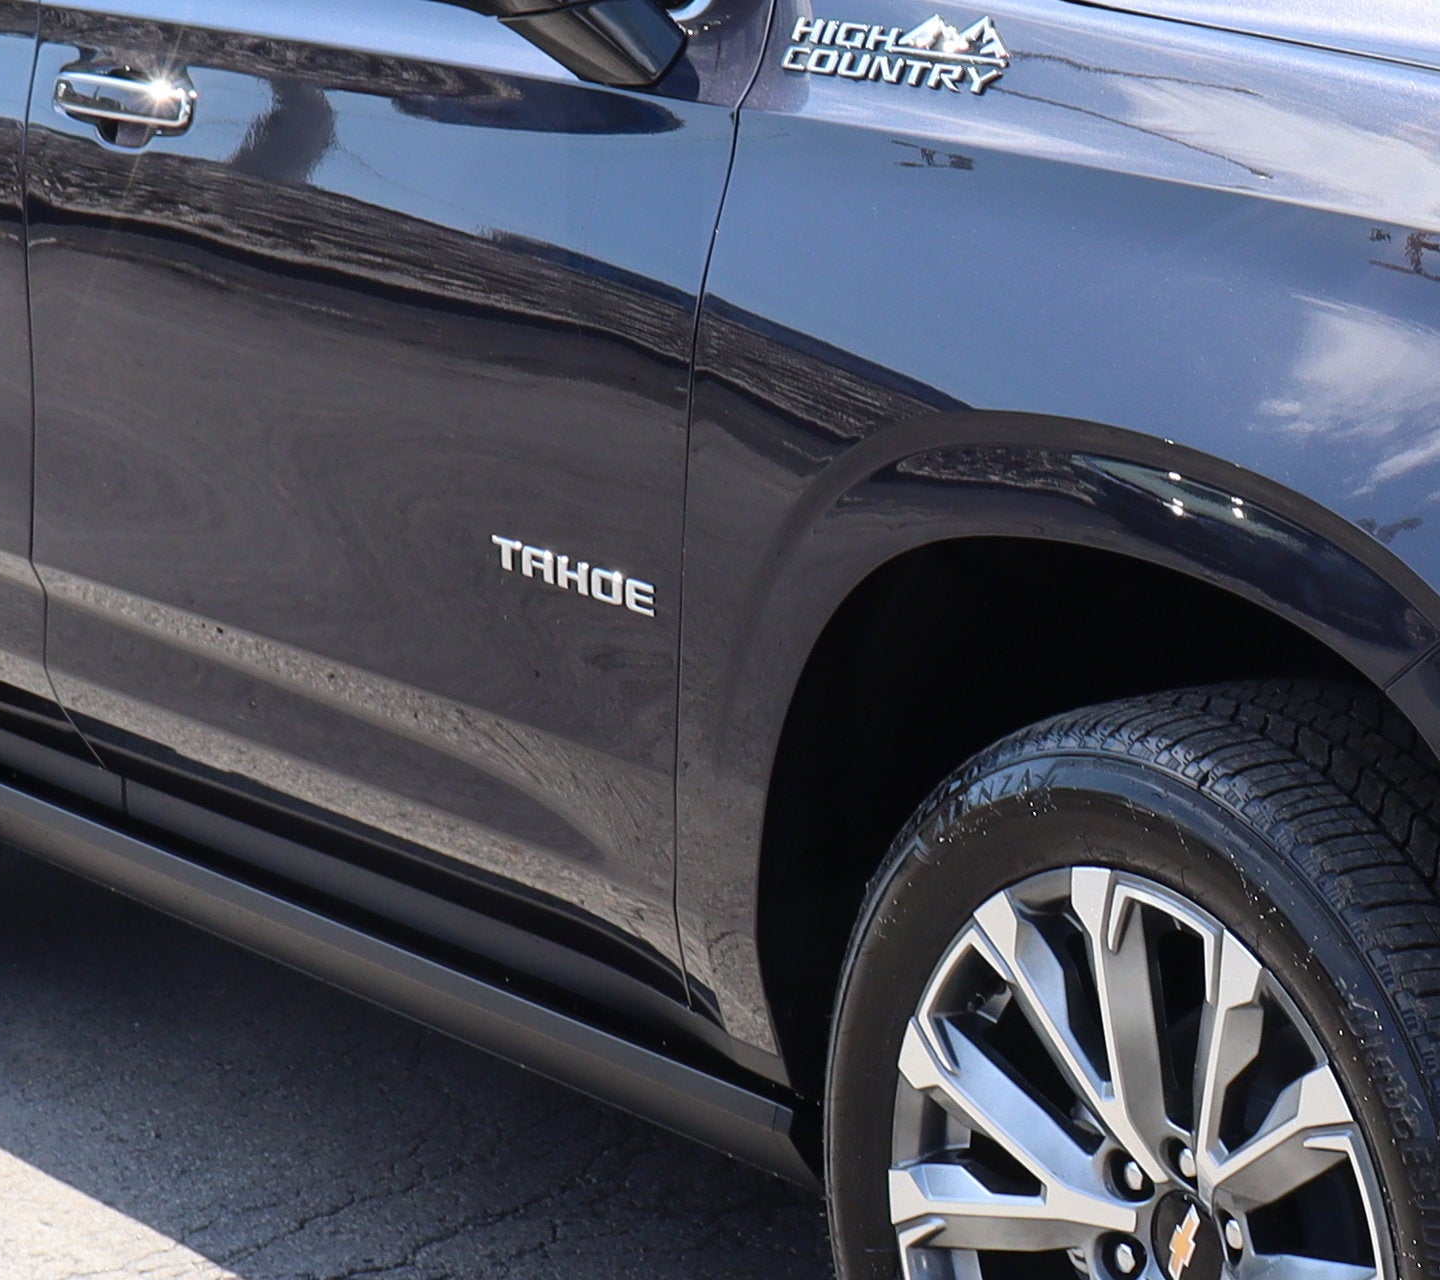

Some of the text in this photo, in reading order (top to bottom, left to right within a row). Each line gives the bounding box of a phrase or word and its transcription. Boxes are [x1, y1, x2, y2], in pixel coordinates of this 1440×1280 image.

[791, 16, 902, 53] HIGH
[781, 46, 1003, 95] COUNTRY
[491, 534, 657, 618] TAHOE
